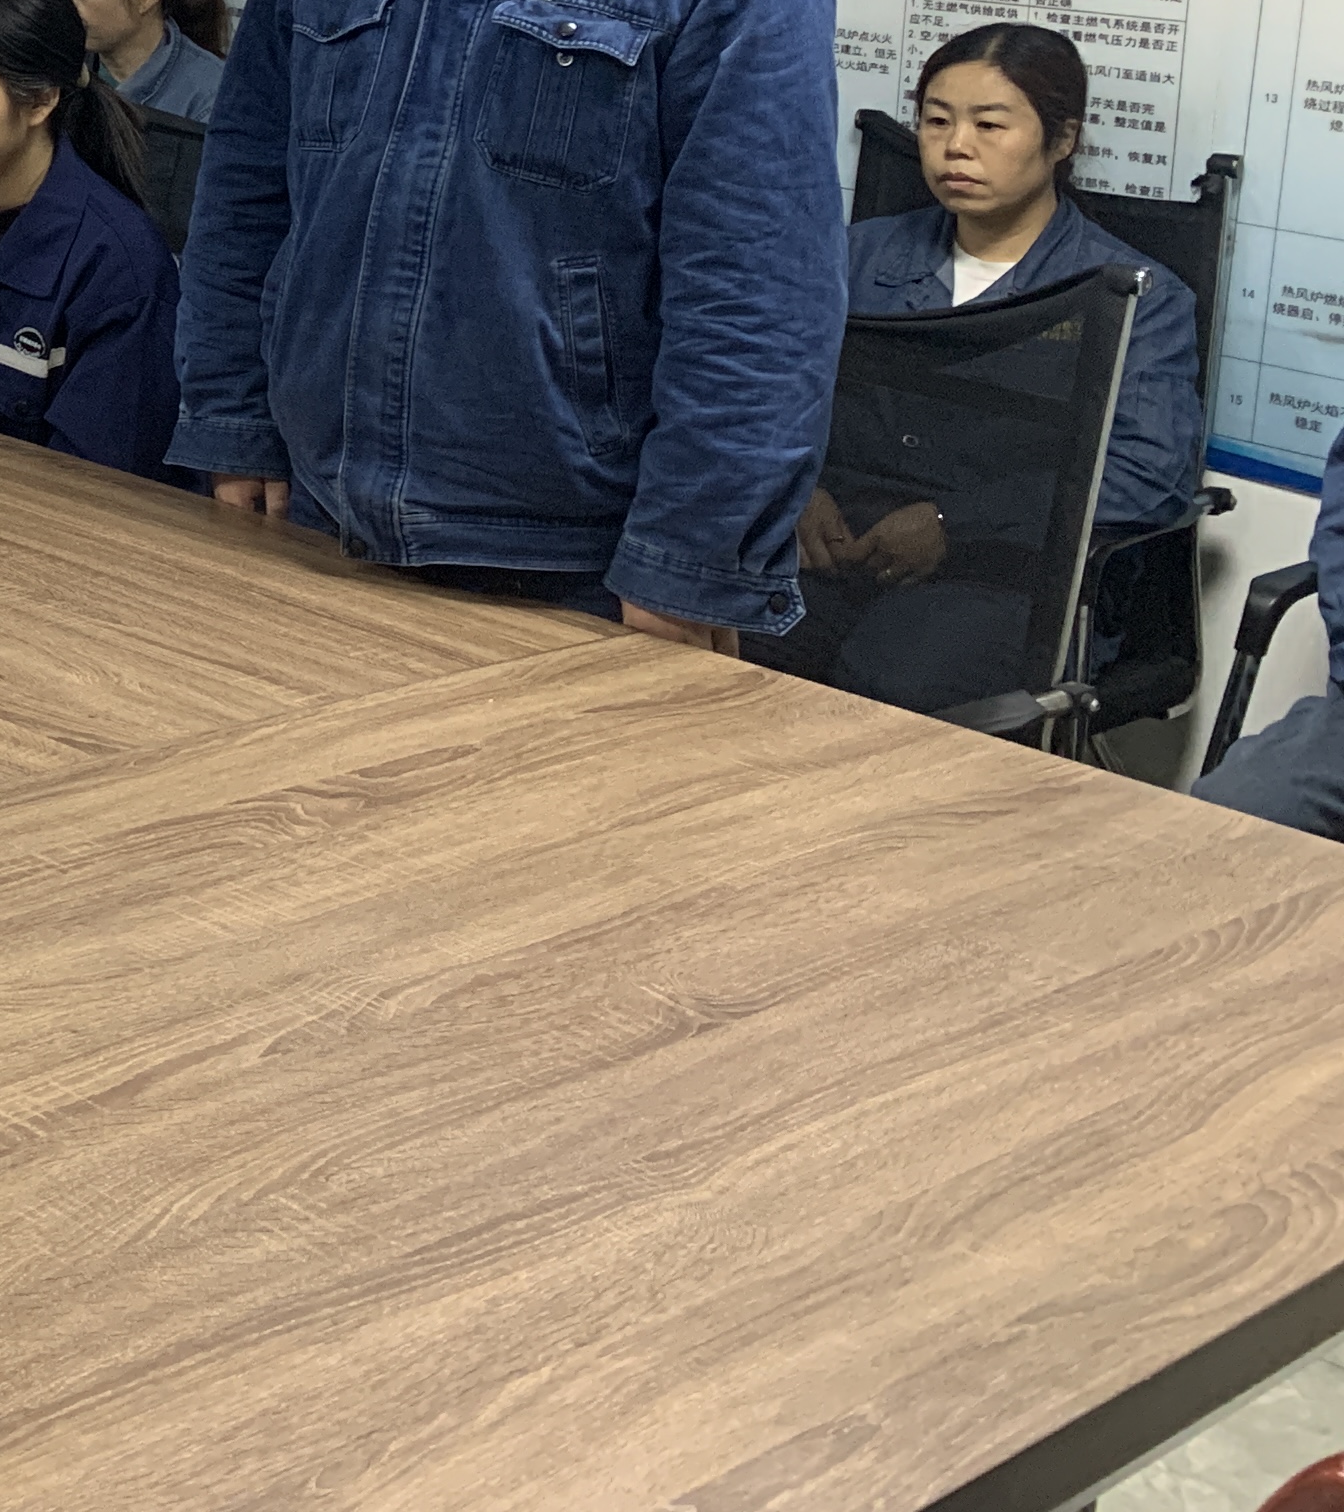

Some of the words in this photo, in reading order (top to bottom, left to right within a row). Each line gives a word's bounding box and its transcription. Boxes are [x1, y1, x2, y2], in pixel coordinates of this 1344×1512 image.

[909, 13, 951, 27] 应不足。
[1046, 11, 1179, 35] 检查主燃气系统是否开
[1264, 92, 1278, 104] 13
[1241, 287, 1255, 299] 14
[1229, 394, 1243, 406] 15
[1294, 416, 1323, 433] 稳定
